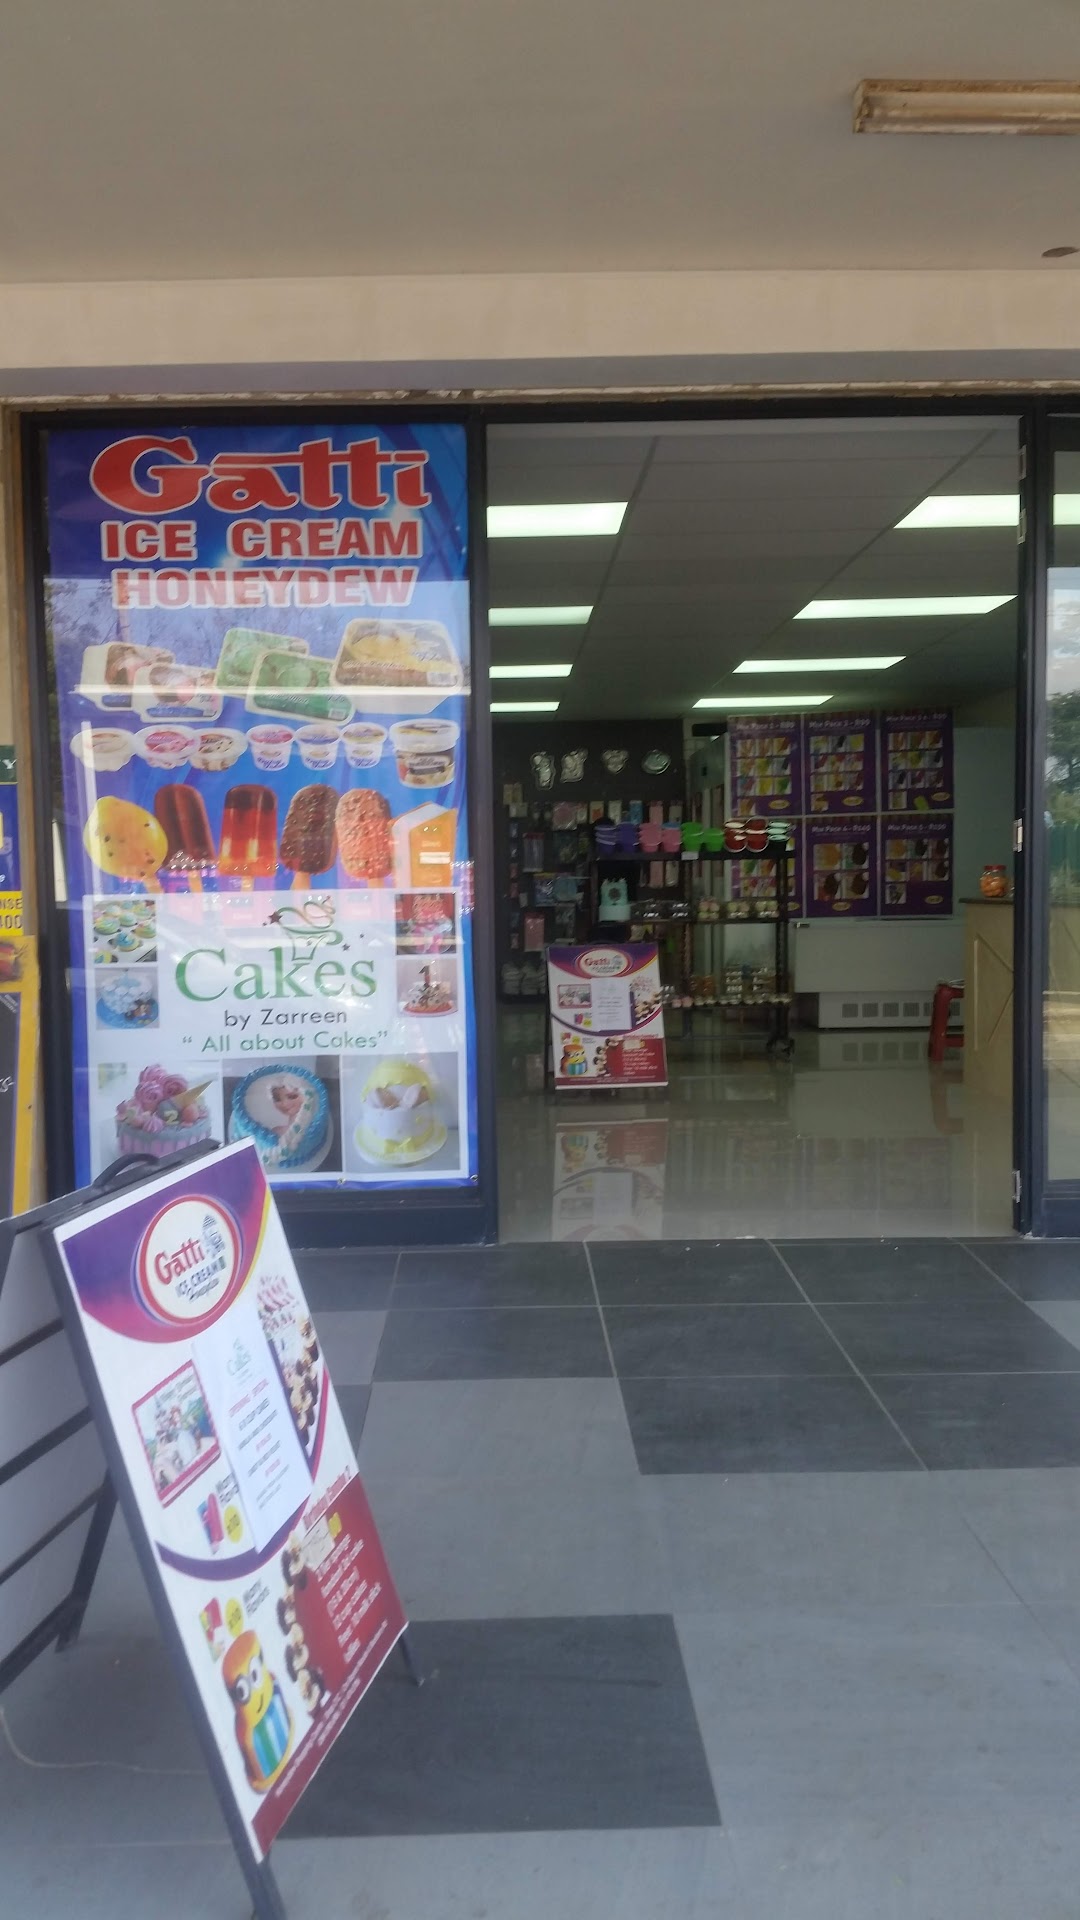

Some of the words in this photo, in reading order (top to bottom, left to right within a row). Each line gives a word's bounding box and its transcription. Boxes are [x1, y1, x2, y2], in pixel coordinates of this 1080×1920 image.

[90, 435, 432, 515] Gatti
[102, 521, 196, 561] ICE
[227, 518, 423, 560] CREAM
[111, 567, 419, 608] HONEYDEW
[175, 945, 377, 1002] Cakes
[224, 1010, 251, 1030] by
[260, 1009, 347, 1027] Zarreen
[202, 1033, 230, 1052] All
[240, 1033, 305, 1052] about
[154, 1240, 204, 1284] Gatti
[190, 1261, 221, 1287] CREAM
[216, 1471, 236, 1494] Man
